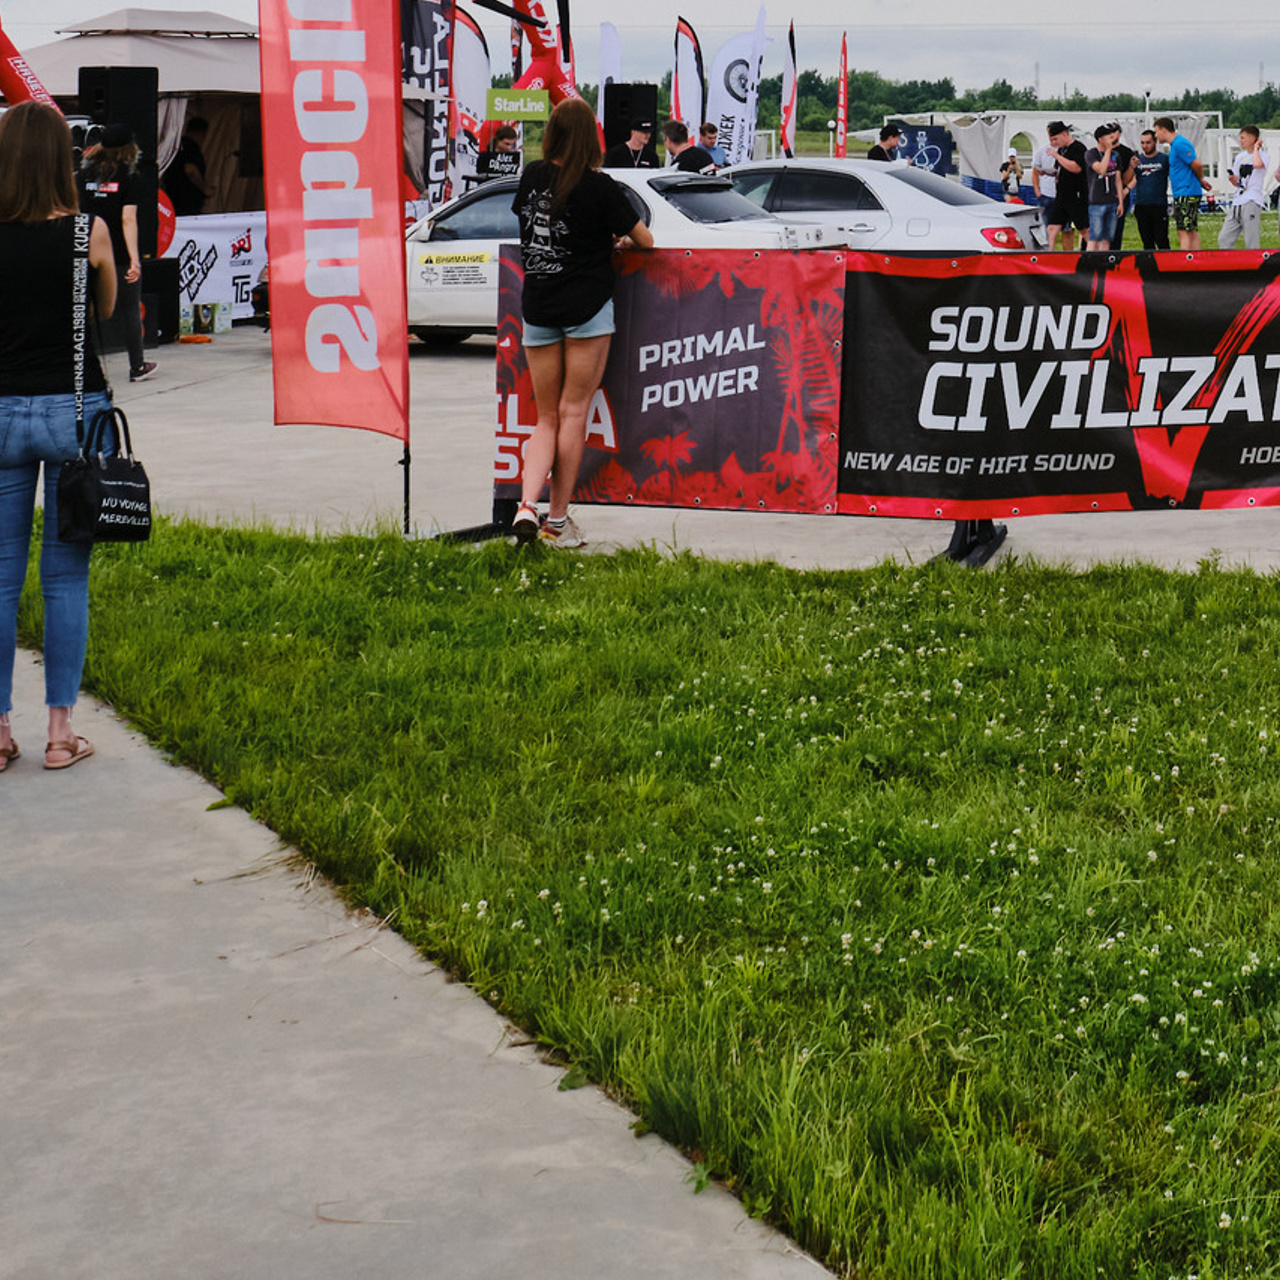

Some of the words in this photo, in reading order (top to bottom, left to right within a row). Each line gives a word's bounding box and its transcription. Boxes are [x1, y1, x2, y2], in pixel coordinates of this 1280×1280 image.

[493, 97, 546, 113] StarLine
[639, 323, 766, 373] PRIMAL
[928, 304, 1111, 353] SOUND
[641, 365, 759, 413] POWER
[844, 451, 894, 471] NEW
[896, 454, 942, 473] AGE
[945, 456, 973, 475] OF
[979, 455, 1029, 475] HIFI
[1033, 453, 1116, 471] SOUND
